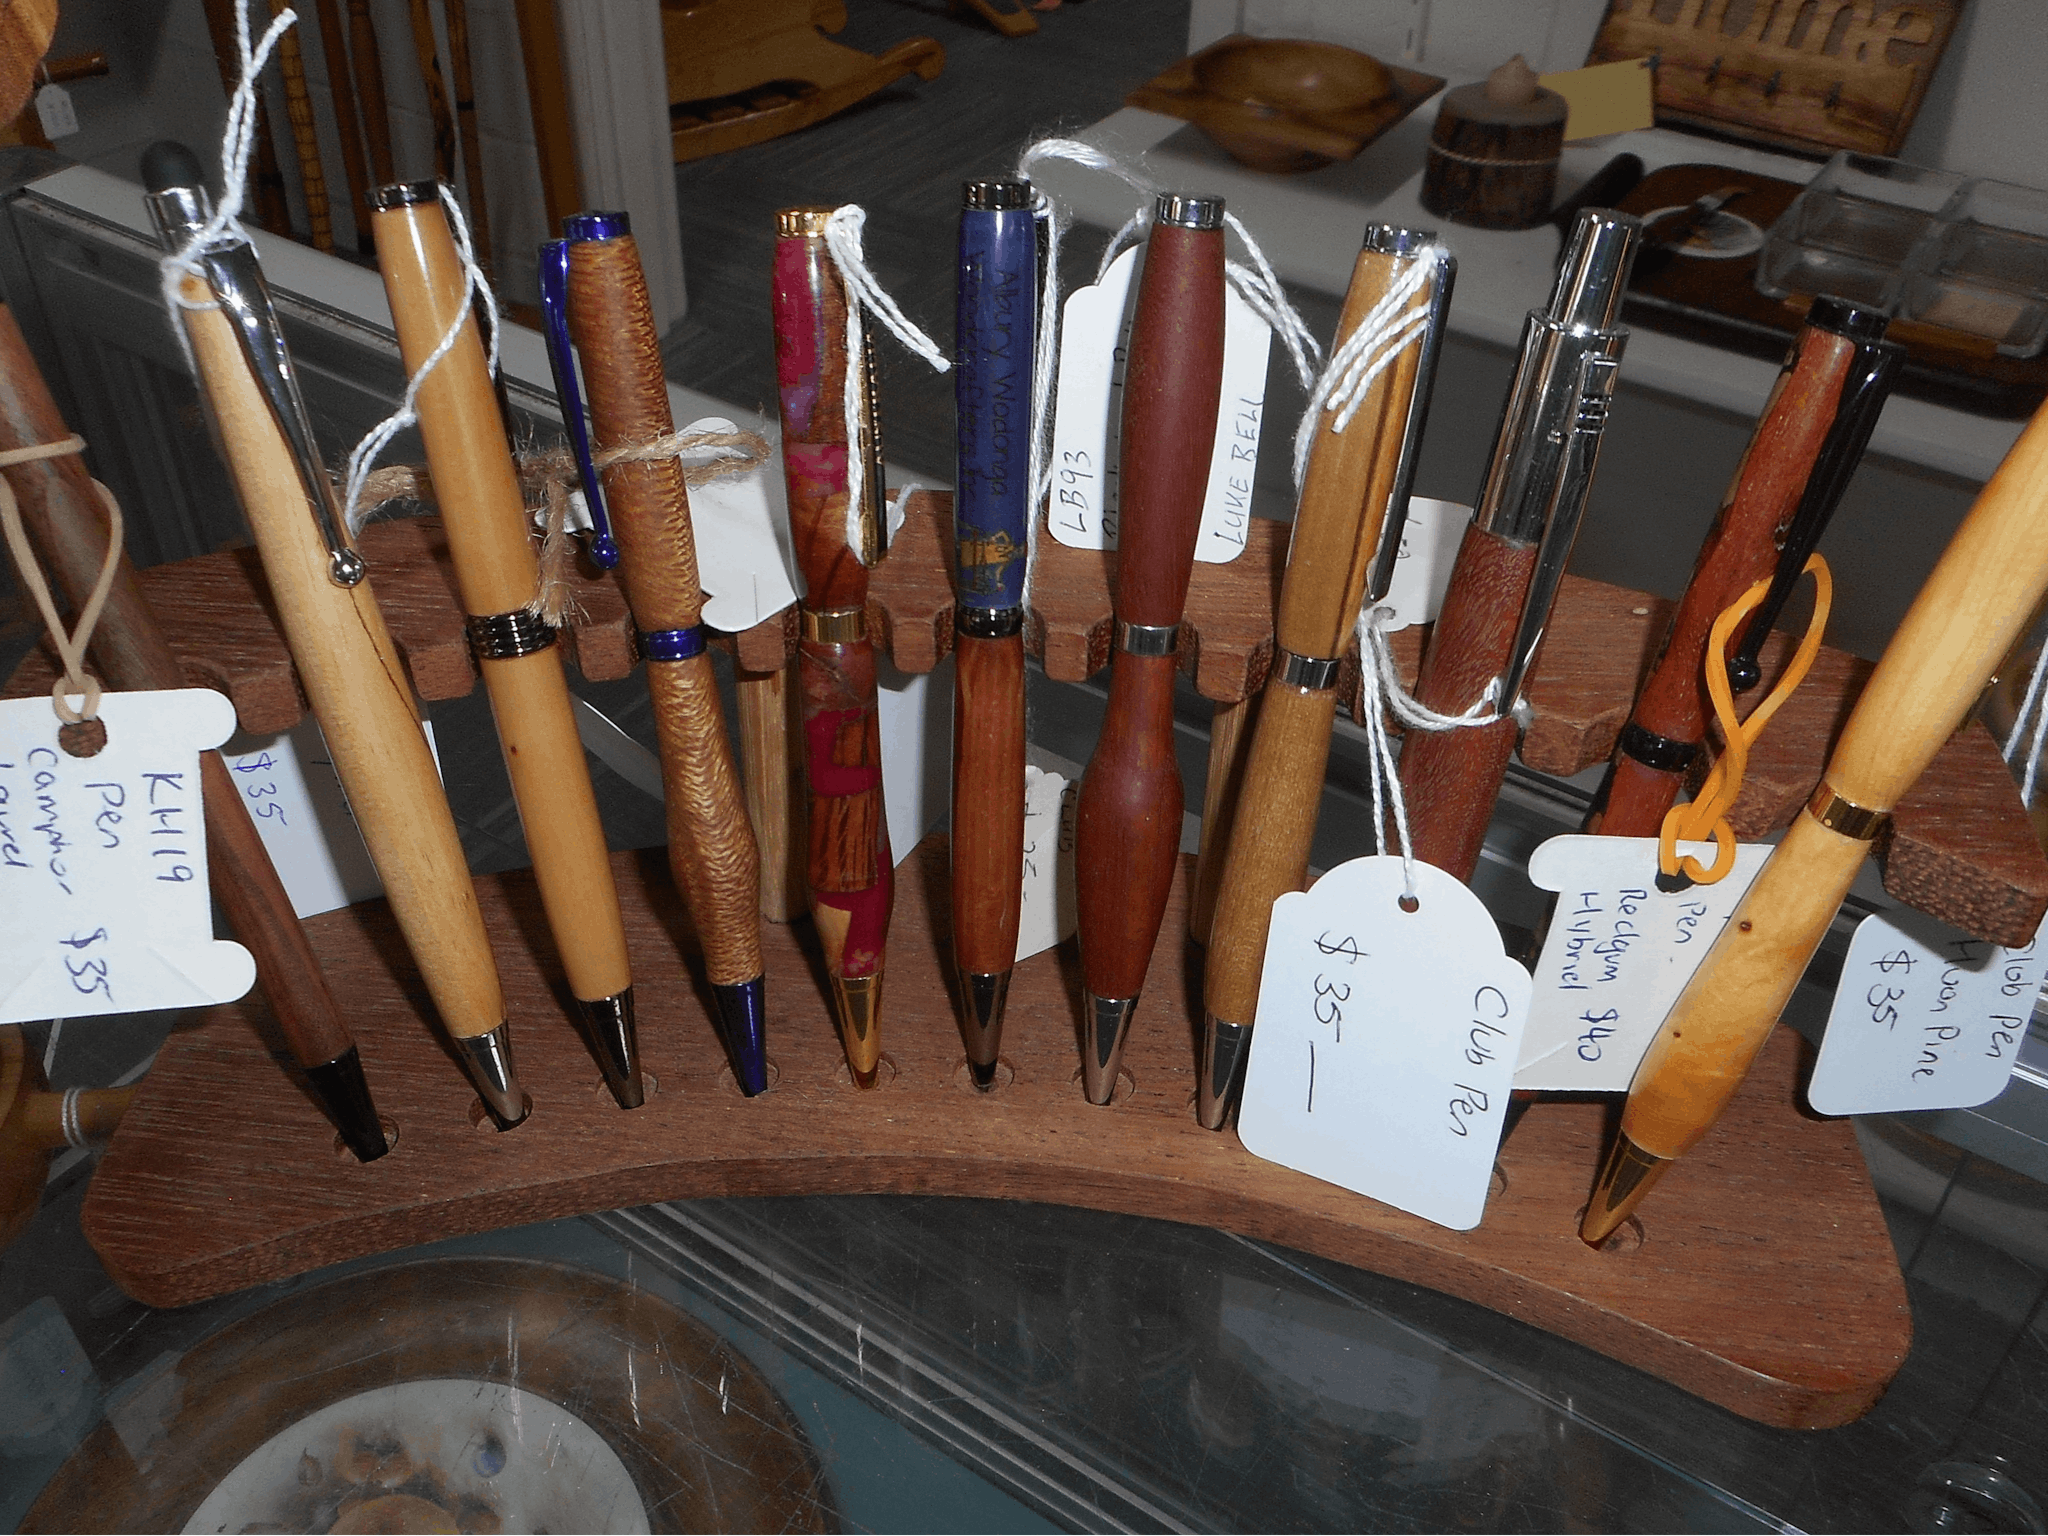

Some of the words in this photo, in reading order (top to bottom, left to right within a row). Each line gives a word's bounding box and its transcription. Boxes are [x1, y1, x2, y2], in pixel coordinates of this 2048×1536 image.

[983, 268, 1020, 360] Albury
[982, 371, 1018, 497] Wodonga
[1231, 398, 1265, 463] BELL
[1059, 450, 1094, 534] LB93
[1213, 476, 1250, 546] LUKE
[83, 782, 126, 849] Pen
[1673, 901, 1708, 944] Pen
[1464, 985, 1509, 1066] Club
[1577, 1008, 1621, 1063] $40
[1911, 1025, 1961, 1084] Pine
[1984, 1015, 2024, 1058] Pen
[1449, 1082, 1489, 1137] Pen
